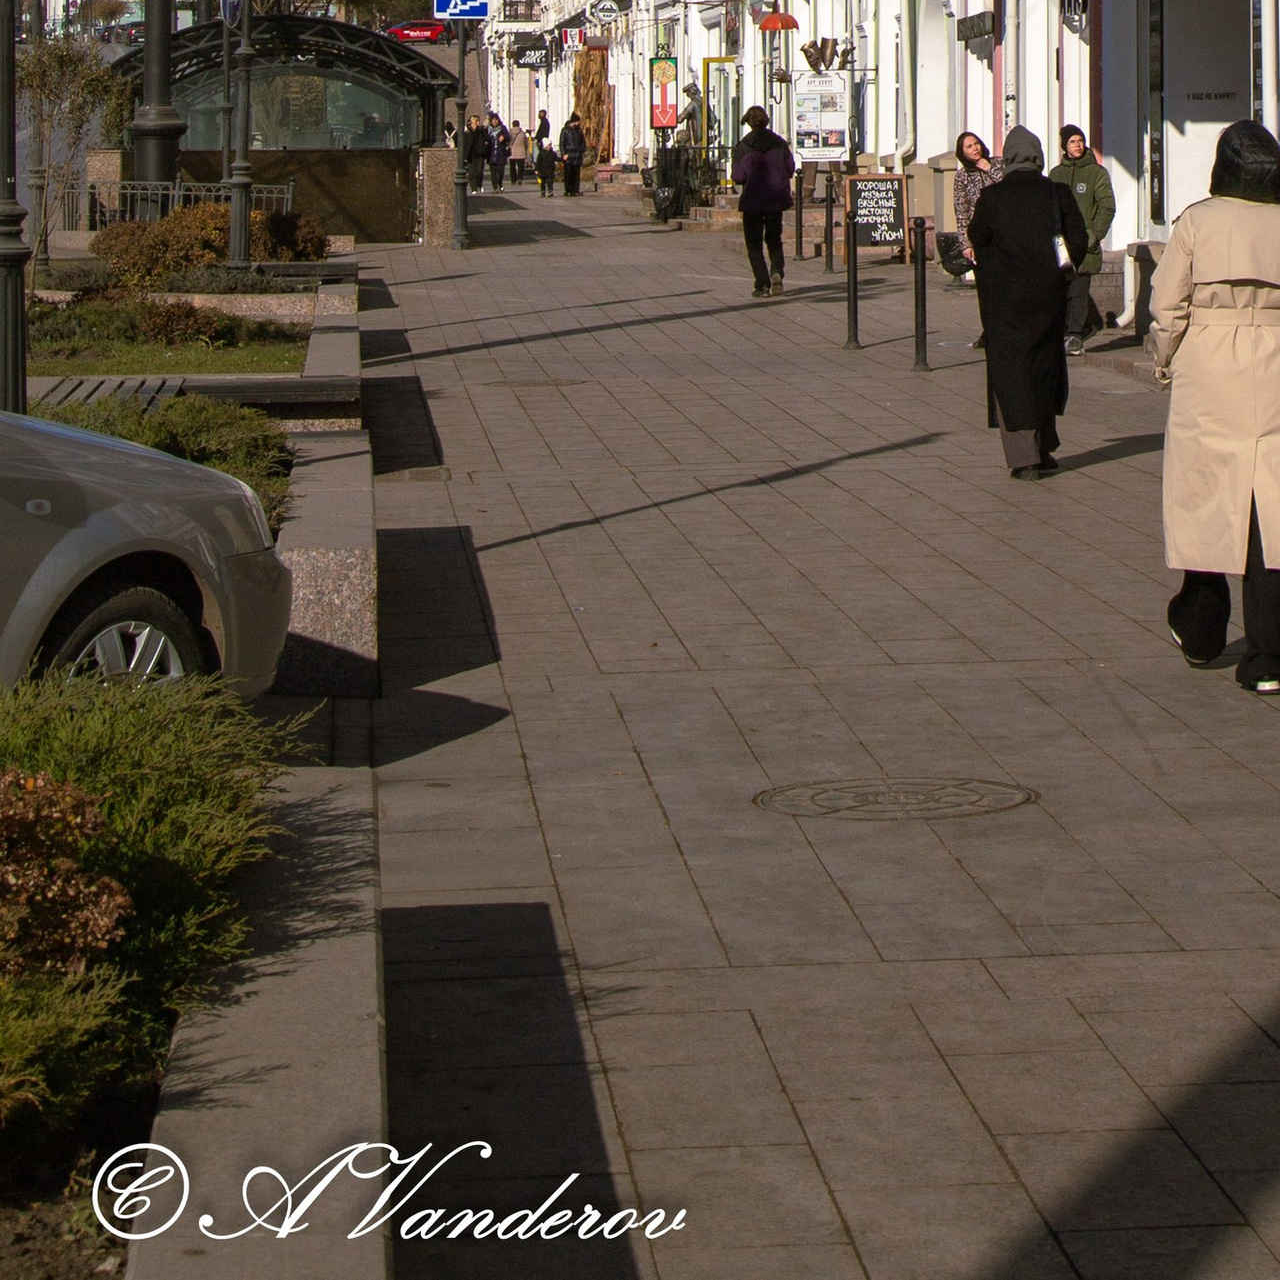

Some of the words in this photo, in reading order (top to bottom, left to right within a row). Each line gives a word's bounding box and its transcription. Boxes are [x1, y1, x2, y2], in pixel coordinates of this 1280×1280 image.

[856, 180, 899, 190] ХОРОШАЯ
[861, 190, 894, 199] МУЗЫКА
[857, 198, 897, 208] ВКУСНЫЕ
[877, 223, 888, 232] ЗА
[871, 228, 904, 241] УГЛОМ!
